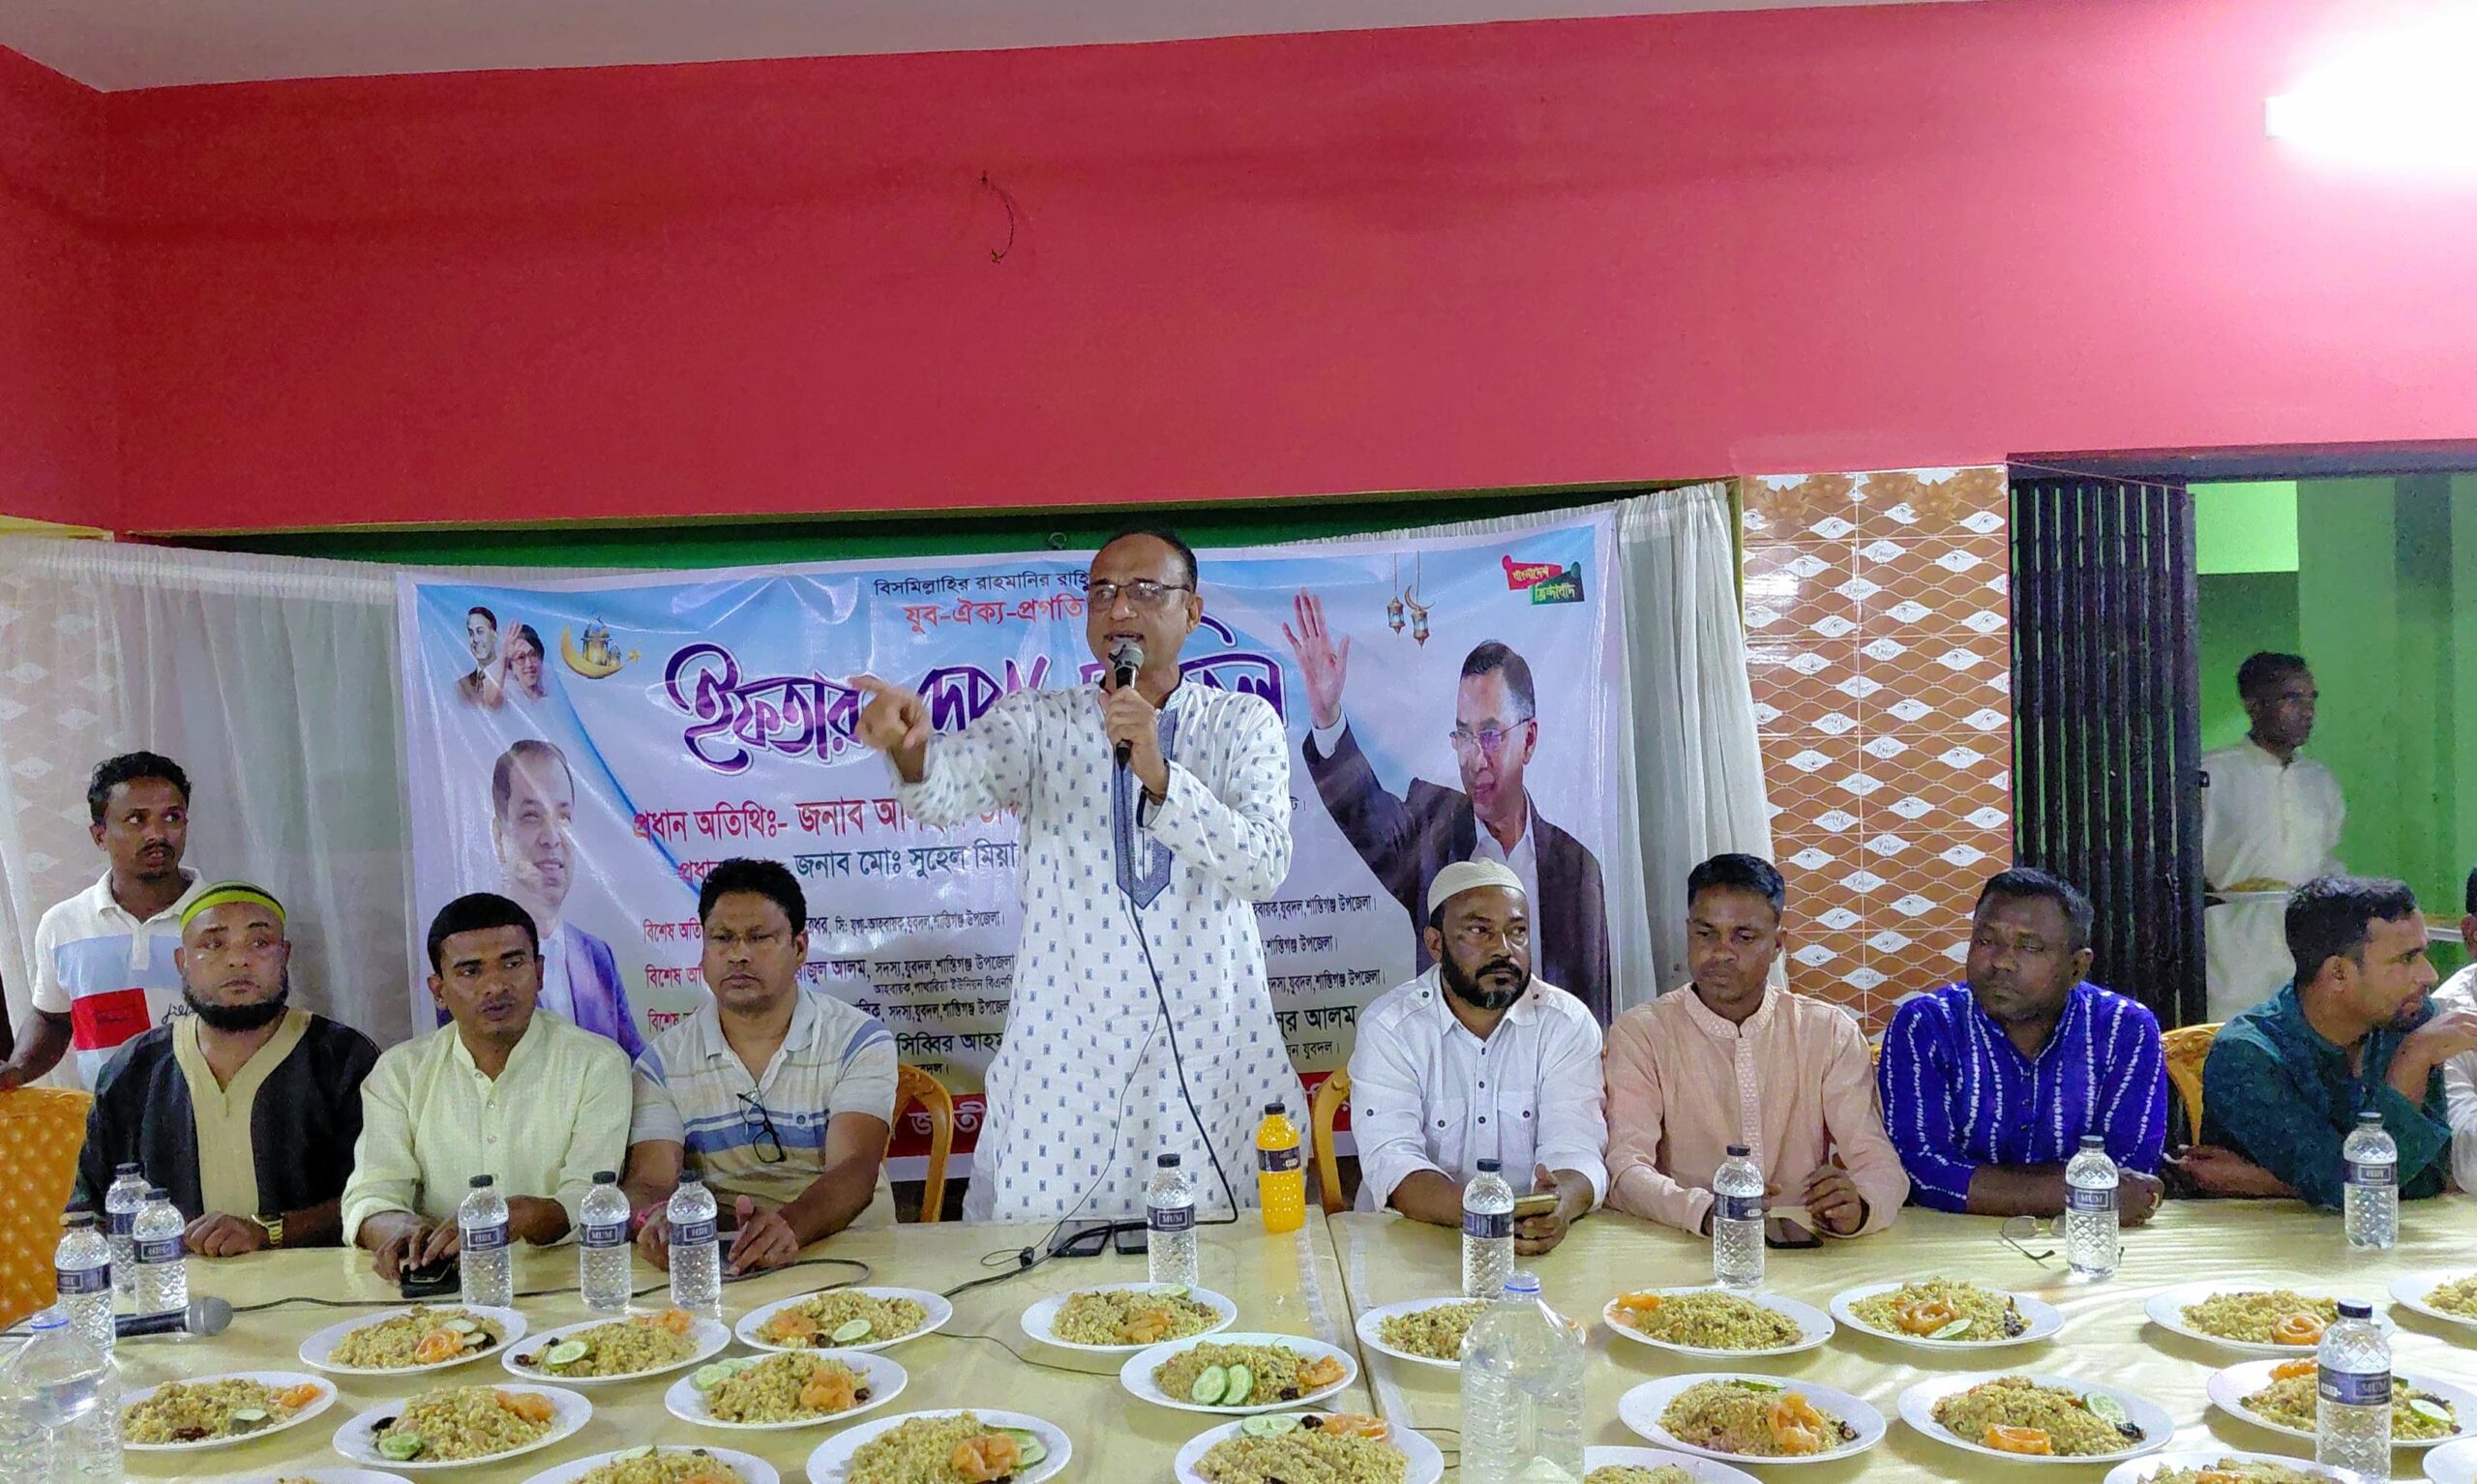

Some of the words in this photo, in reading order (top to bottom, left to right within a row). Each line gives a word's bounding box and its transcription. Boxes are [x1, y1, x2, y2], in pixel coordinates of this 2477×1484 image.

[874, 576, 970, 596] বিসমিল্লাহির
[975, 570, 1050, 592] রাহমানির
[1057, 569, 1089, 591] রাহি
[633, 809, 688, 843] প্রধান
[794, 796, 866, 836] জনাব
[793, 849, 851, 878] জনাব
[857, 846, 901, 876] মোঃ
[908, 845, 968, 879] সুহেল
[973, 838, 1017, 870] মিয়া
[642, 918, 675, 943] বিশেষ
[678, 916, 701, 941] অতি
[645, 964, 683, 989] বিশেষ
[977, 997, 1010, 1015] উপজেল
[1304, 1005, 1358, 1030] আলম
[2081, 1194, 2103, 1203] MUM
[1162, 1214, 1183, 1224] MUM
[591, 1230, 612, 1239] MUM
